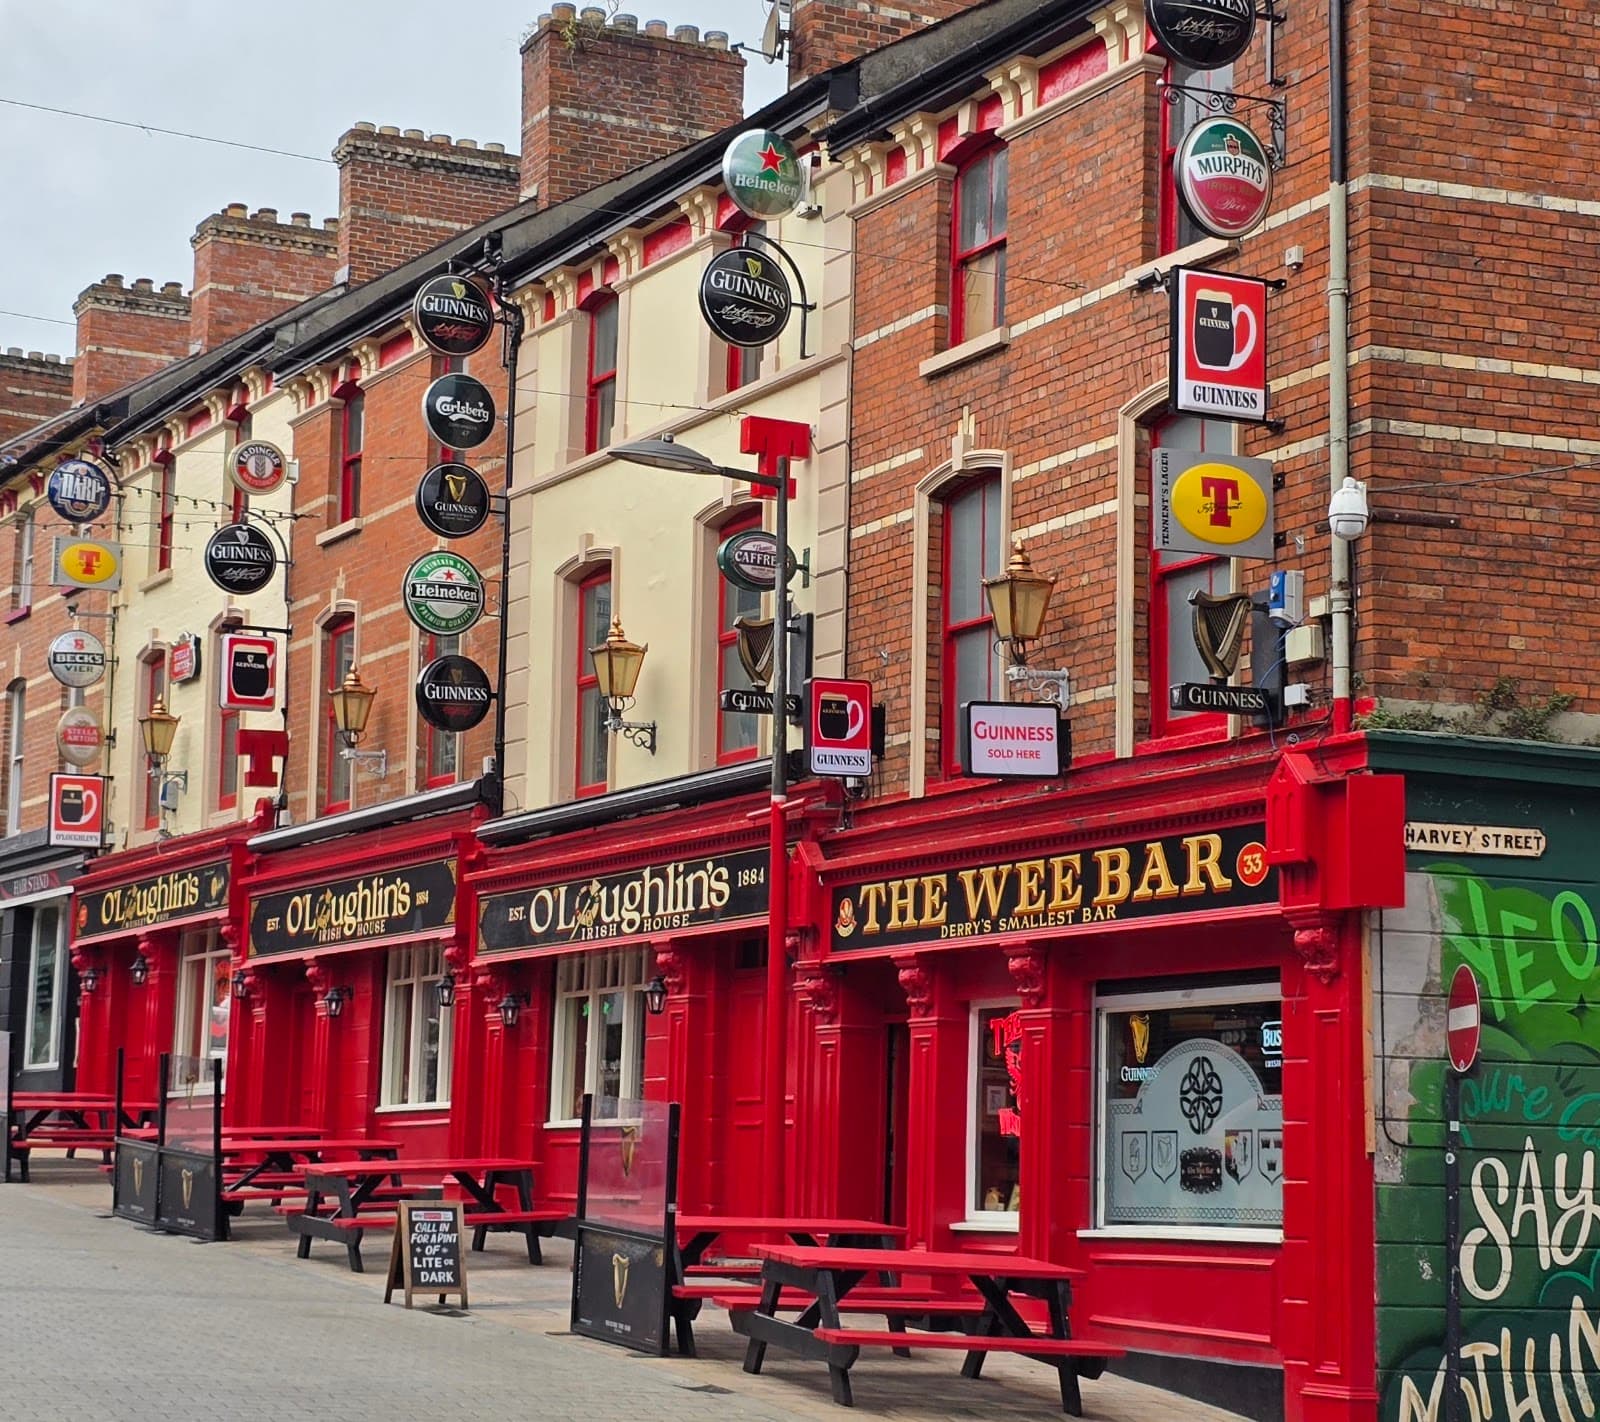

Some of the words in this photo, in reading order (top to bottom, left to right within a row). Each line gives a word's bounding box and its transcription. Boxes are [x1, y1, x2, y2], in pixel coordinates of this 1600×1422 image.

[735, 173, 798, 198] Heineken
[710, 269, 787, 310] GUINNESS
[422, 295, 489, 323] GUINNESS
[1199, 317, 1230, 330] GUINNESS
[1193, 384, 1258, 409] GUINNESS
[435, 395, 489, 422] Carlsberg
[239, 446, 281, 466] ERDINGER
[61, 472, 105, 503] HARP
[435, 501, 478, 514] GUINNESS
[1201, 476, 1240, 527] T
[78, 549, 101, 575] T
[211, 545, 272, 561] GUINNESS
[734, 551, 790, 568] CAFFRE
[414, 583, 477, 601] Heineken
[424, 682, 488, 701] GUINNESS
[731, 692, 796, 711] GUINNSS
[1188, 686, 1265, 709] GUINNESS
[974, 720, 1054, 742] GUINNESS
[816, 753, 866, 767] GUINNESS
[987, 748, 1014, 758] SOLD
[1016, 750, 1041, 759] HERE
[1405, 828, 1473, 848] HARVEY
[1481, 834, 1543, 850] STREET
[1242, 851, 1264, 876] 33
[859, 873, 948, 934] THE
[956, 853, 1084, 919] WEE
[1093, 832, 1234, 903] BAR
[508, 906, 527, 922] EST.
[737, 867, 765, 887] 1884
[319, 927, 342, 943] IRISH
[357, 919, 386, 936] HOUSE
[581, 923, 617, 941] IRISH
[643, 913, 690, 932] HOUSE
[940, 918, 993, 939] DERRY'S
[998, 909, 1076, 932] SMALLEST
[1082, 903, 1118, 923] BAR
[411, 1232, 430, 1244] FOR
[430, 1233, 437, 1244] A
[437, 1232, 458, 1244] PINT
[414, 1222, 438, 1233] CALL
[439, 1222, 451, 1232] IN
[424, 1245, 441, 1256] OF
[413, 1257, 443, 1268] LITE
[420, 1271, 455, 1283] DARK
